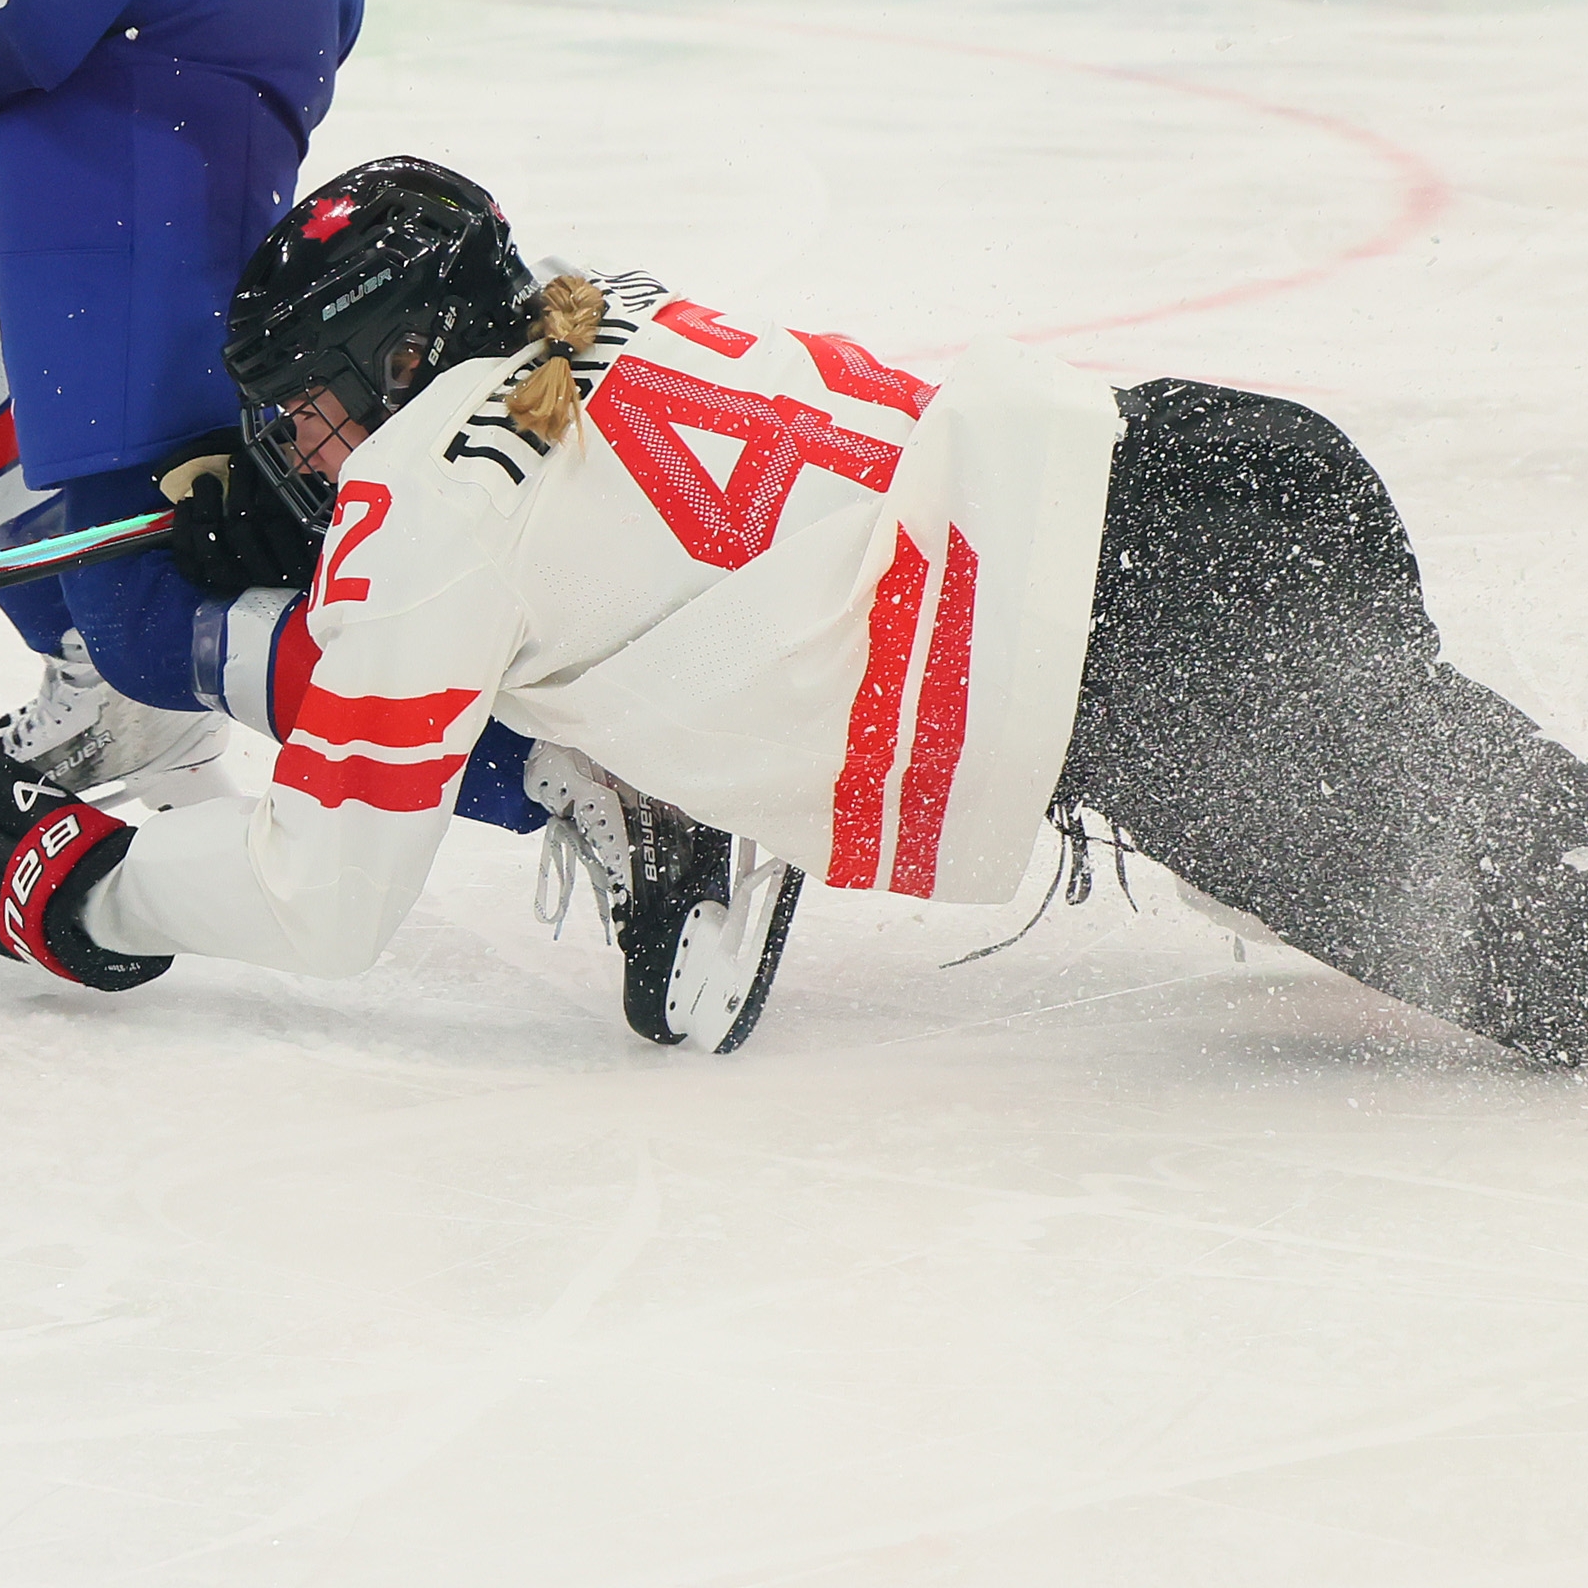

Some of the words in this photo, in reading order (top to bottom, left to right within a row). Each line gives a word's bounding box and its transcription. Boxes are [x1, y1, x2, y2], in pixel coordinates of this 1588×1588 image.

[322, 267, 393, 322] BAUER
[638, 791, 659, 882] BAUER
[3, 813, 84, 957] BAU
